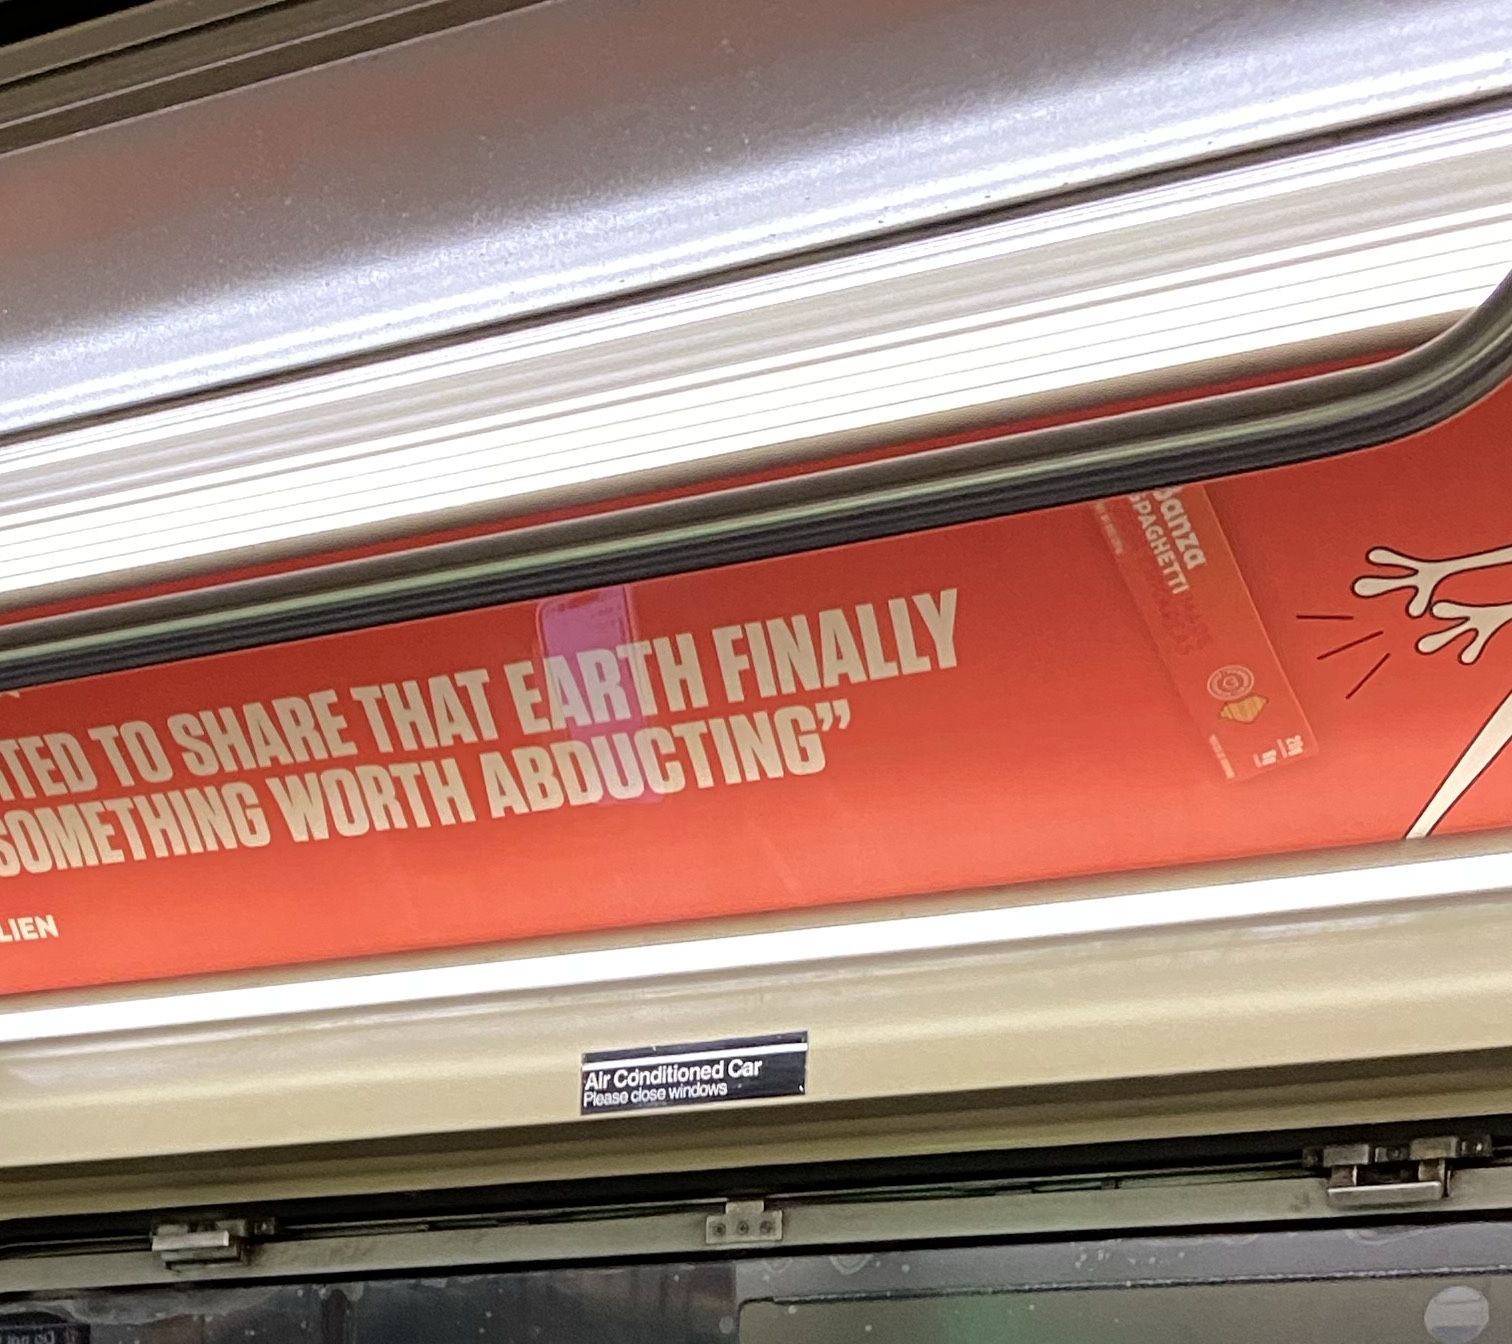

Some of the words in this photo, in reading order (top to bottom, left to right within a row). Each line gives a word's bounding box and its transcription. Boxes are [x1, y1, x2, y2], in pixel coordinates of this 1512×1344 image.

[88, 720, 173, 787] TO
[167, 688, 358, 776] SHARE
[349, 668, 498, 753] THAT
[504, 632, 709, 736] EARTH
[712, 587, 958, 703] FINALLY
[265, 757, 477, 843] WORTH
[479, 698, 851, 819] ABDUCTING”
[583, 1090, 629, 1108] Please
[630, 1086, 667, 1103] close
[668, 1082, 728, 1099] windows
[584, 1072, 611, 1090] Air
[613, 1061, 724, 1088] Conditioned
[727, 1058, 763, 1078] Car
